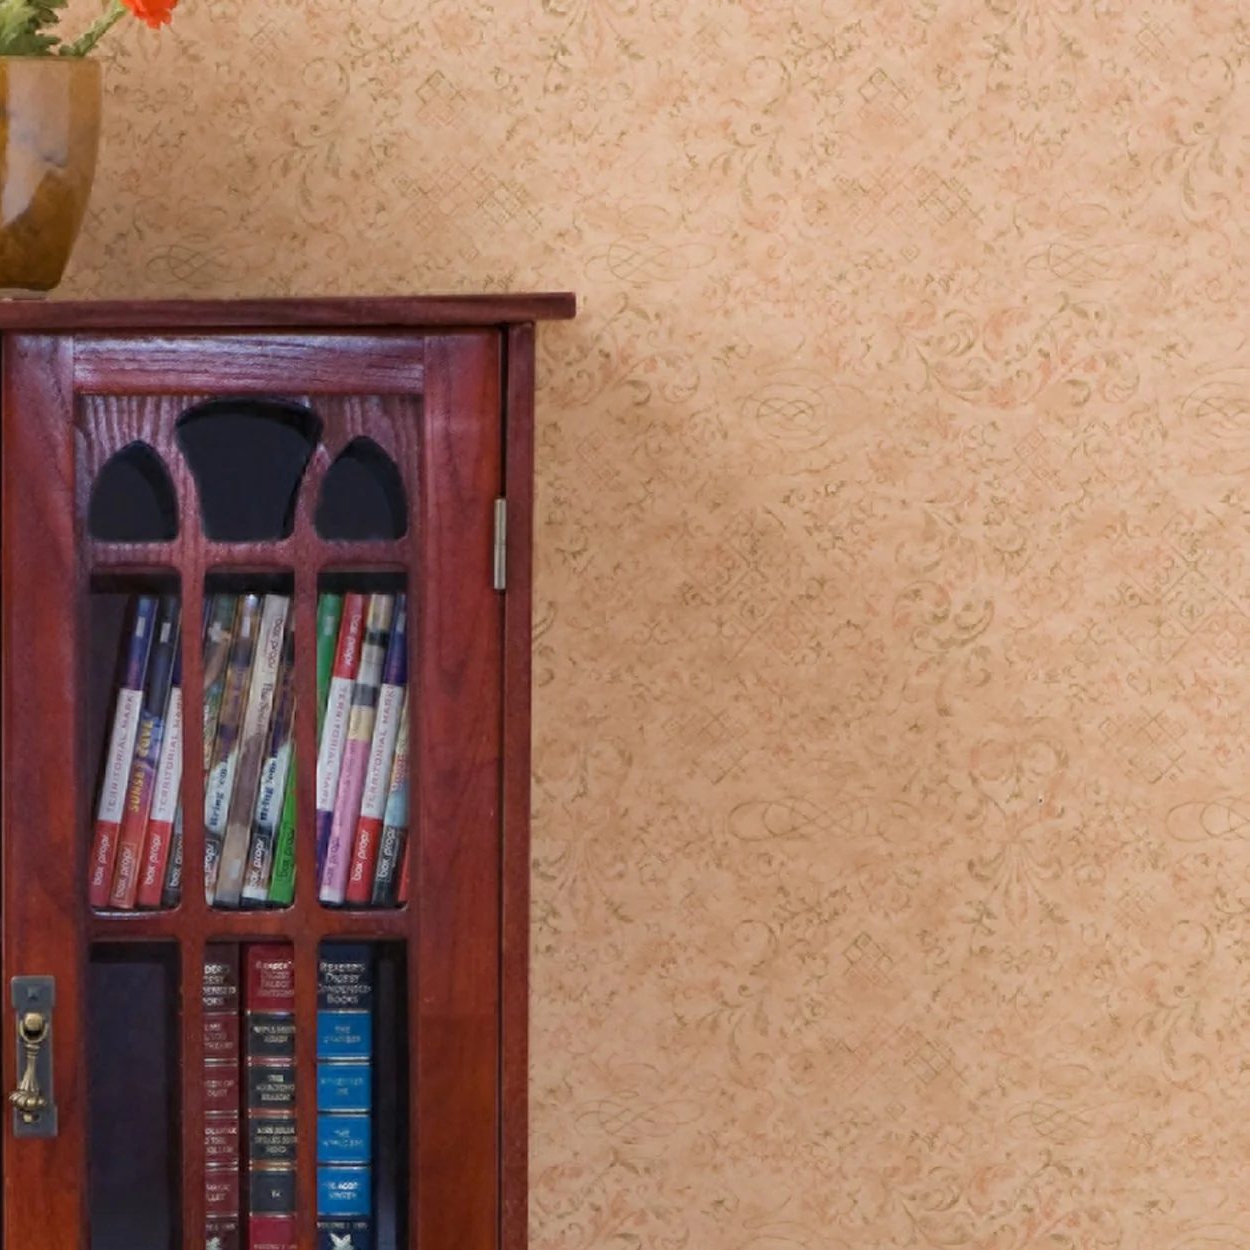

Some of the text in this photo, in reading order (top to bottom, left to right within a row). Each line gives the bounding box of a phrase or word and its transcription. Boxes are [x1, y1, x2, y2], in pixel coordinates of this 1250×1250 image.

[351, 614, 362, 634] box
[129, 720, 154, 813] SUNSET COVE
[92, 832, 110, 886] box props
[114, 846, 132, 898] box props
[143, 833, 162, 885] box props
[170, 866, 182, 887] box
[352, 830, 370, 881] box props
[378, 828, 396, 878] box props
